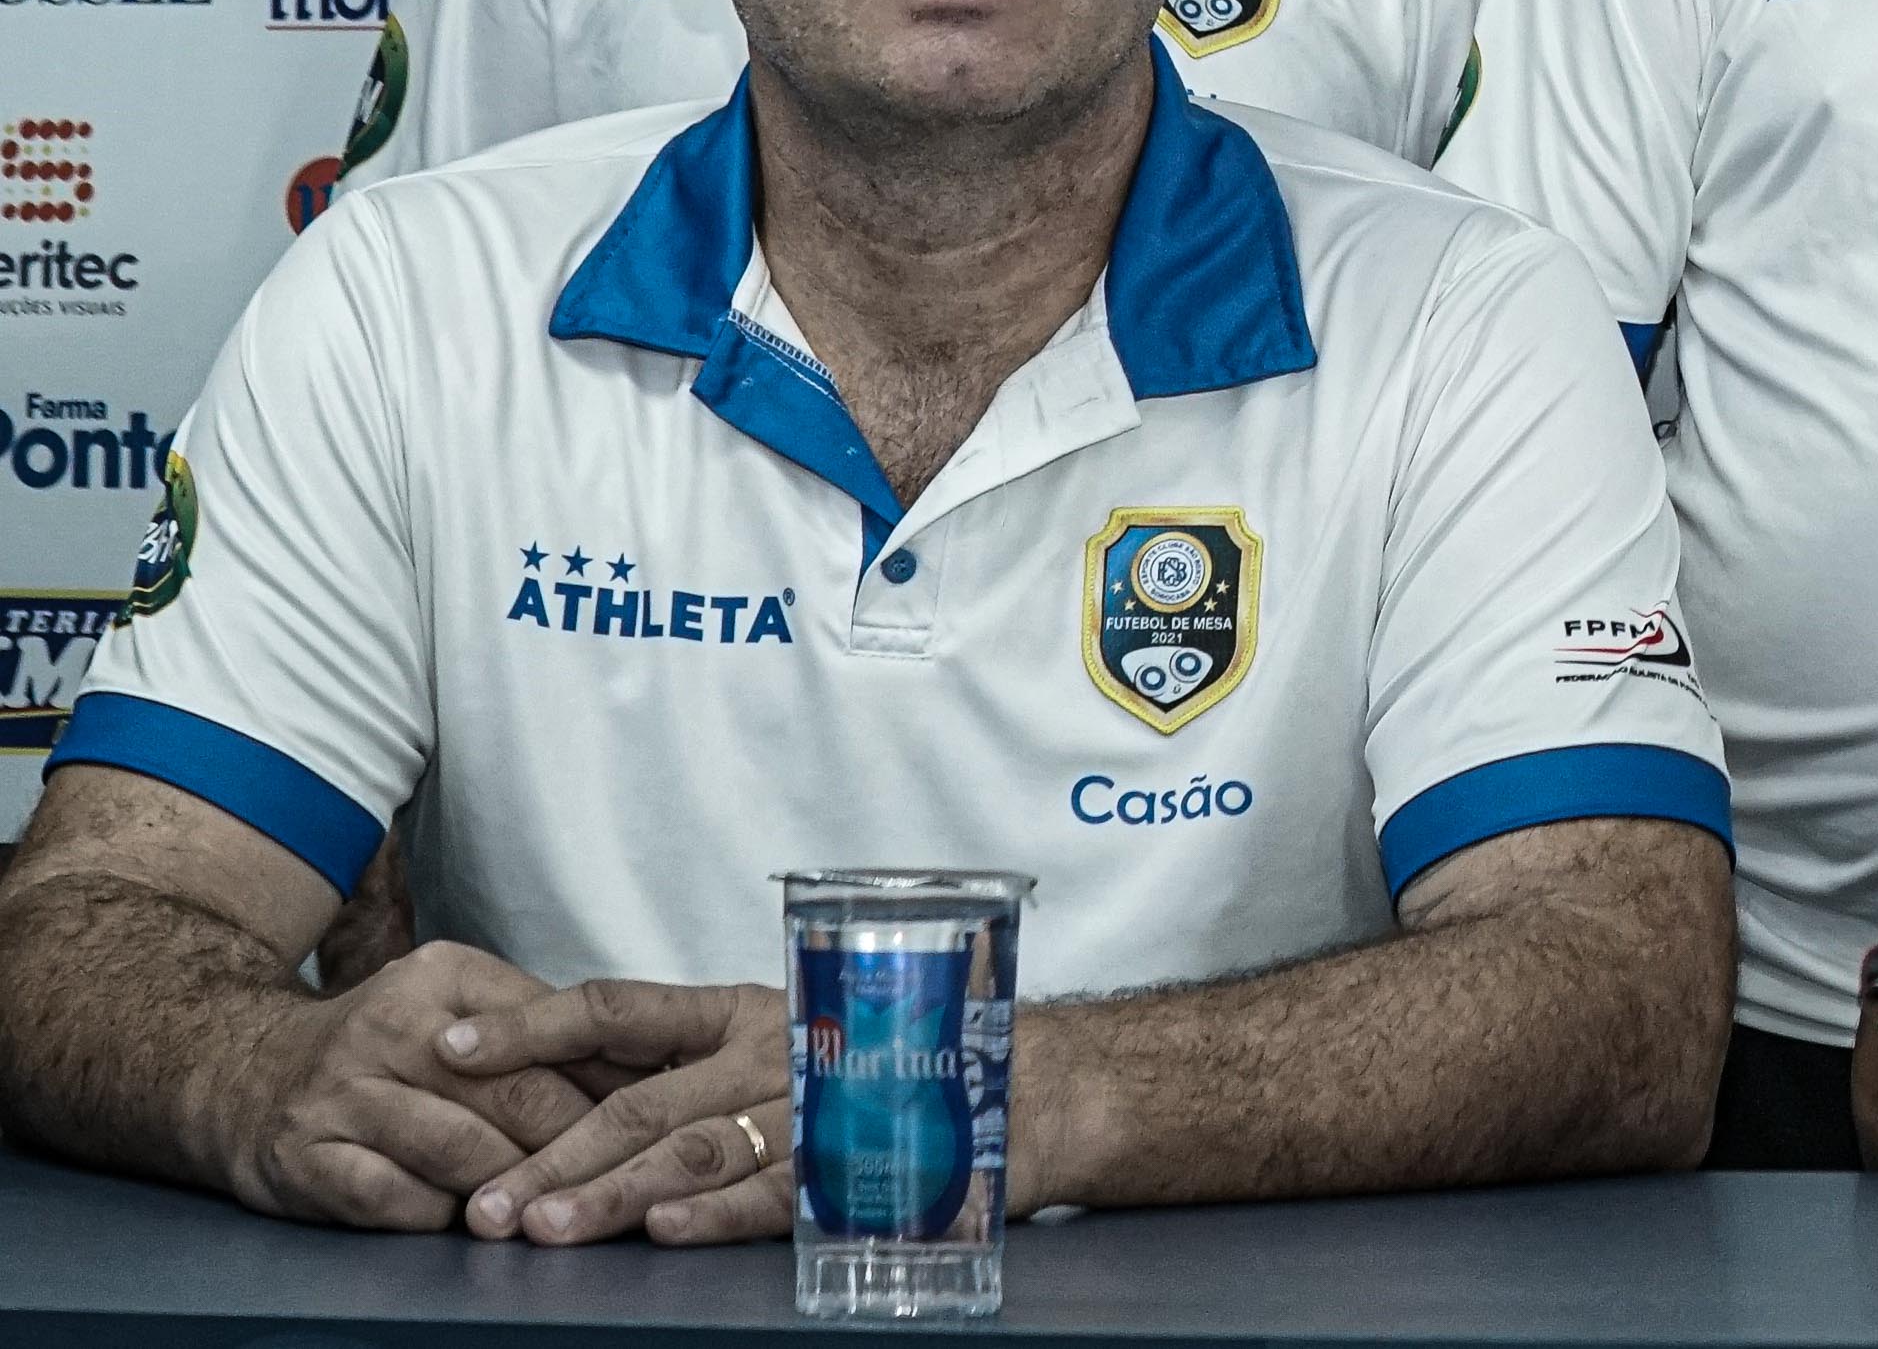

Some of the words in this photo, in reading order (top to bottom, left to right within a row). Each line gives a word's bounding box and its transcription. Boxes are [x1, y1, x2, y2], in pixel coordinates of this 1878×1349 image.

[26, 392, 109, 420] Farma
[507, 576, 793, 646] ATHLETA
[1105, 616, 1168, 631] FUTEBOL
[1171, 616, 1190, 631] DE
[1193, 616, 1233, 631] MESA
[1564, 619, 1656, 639] FPFM
[1151, 632, 1183, 645] 2021
[1071, 774, 1253, 827] Casão
